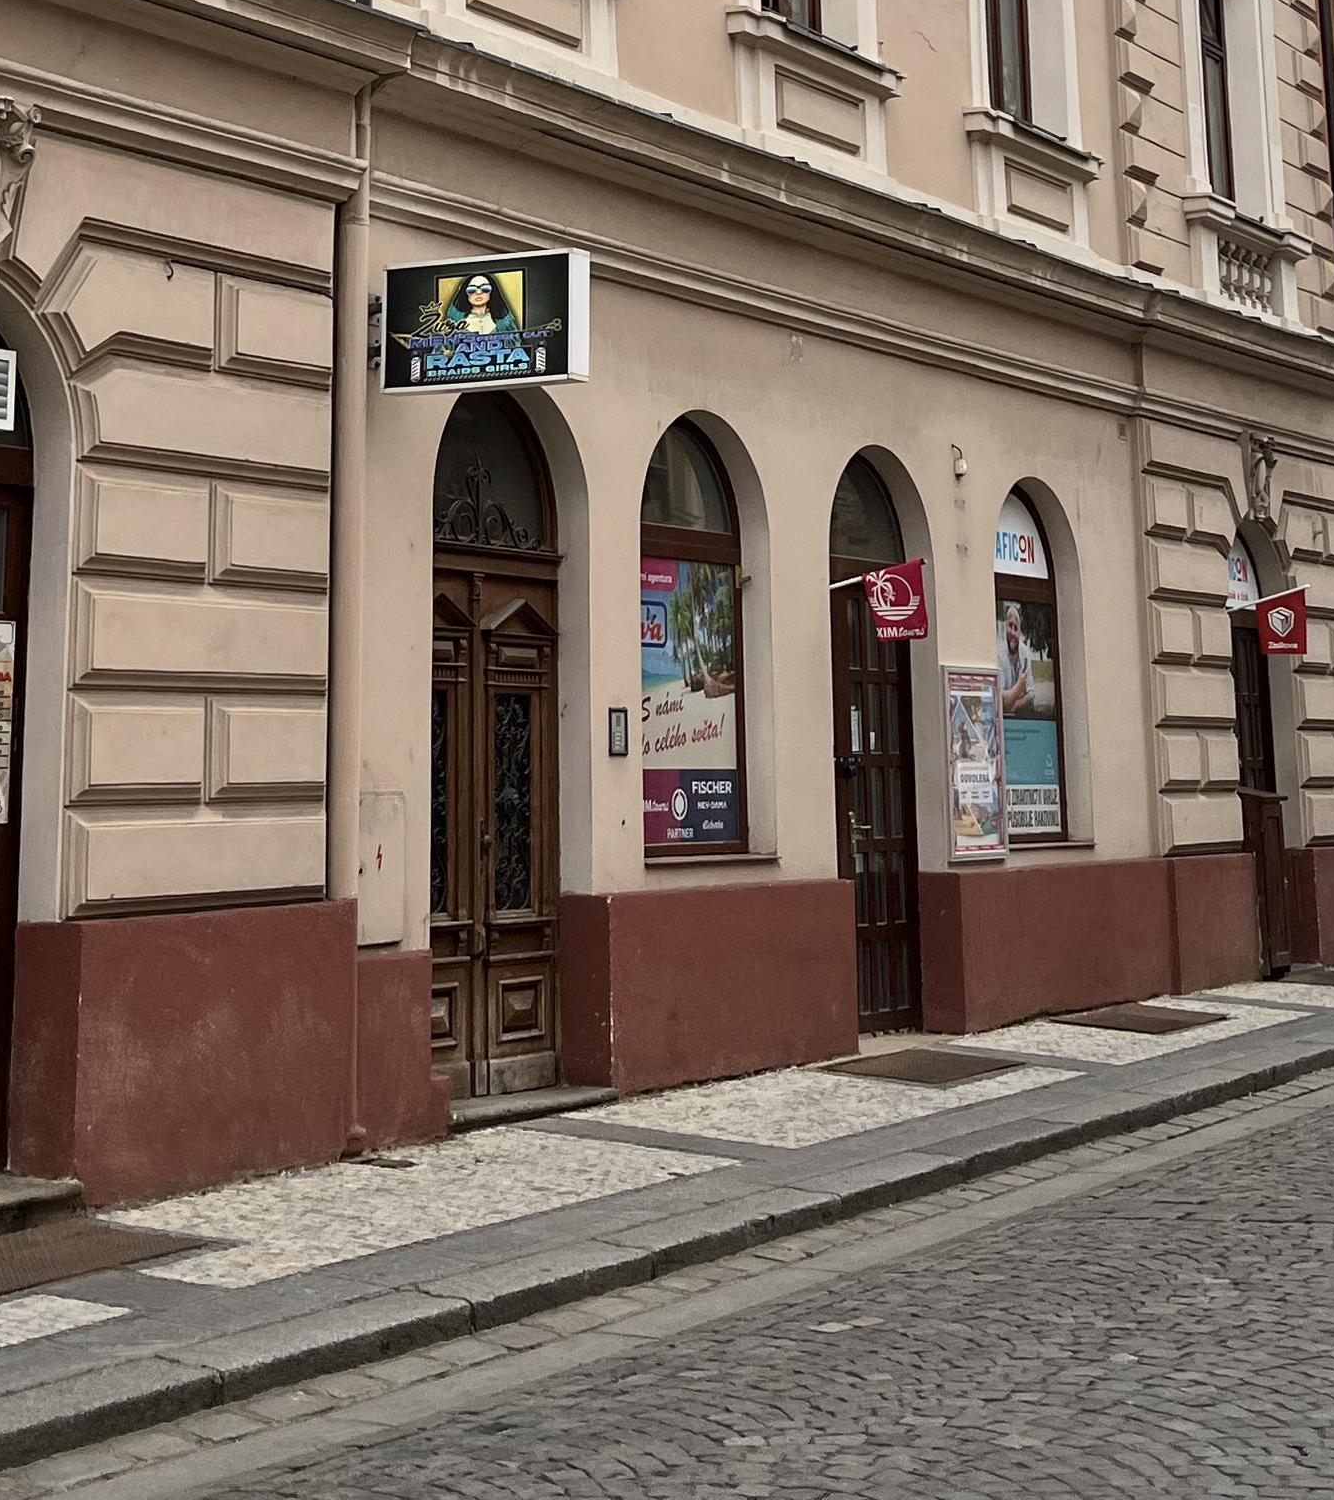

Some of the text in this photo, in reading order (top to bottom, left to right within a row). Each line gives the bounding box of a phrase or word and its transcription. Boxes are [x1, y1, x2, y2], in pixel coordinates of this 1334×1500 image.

[454, 340, 503, 353] AND
[426, 347, 530, 370] RASTA
[427, 362, 529, 377] BRAIDS GIRLS
[995, 531, 1035, 564] AFICON
[642, 692, 684, 723] S námi
[691, 781, 732, 794] FISCHER
[667, 828, 694, 839] PARTNER
